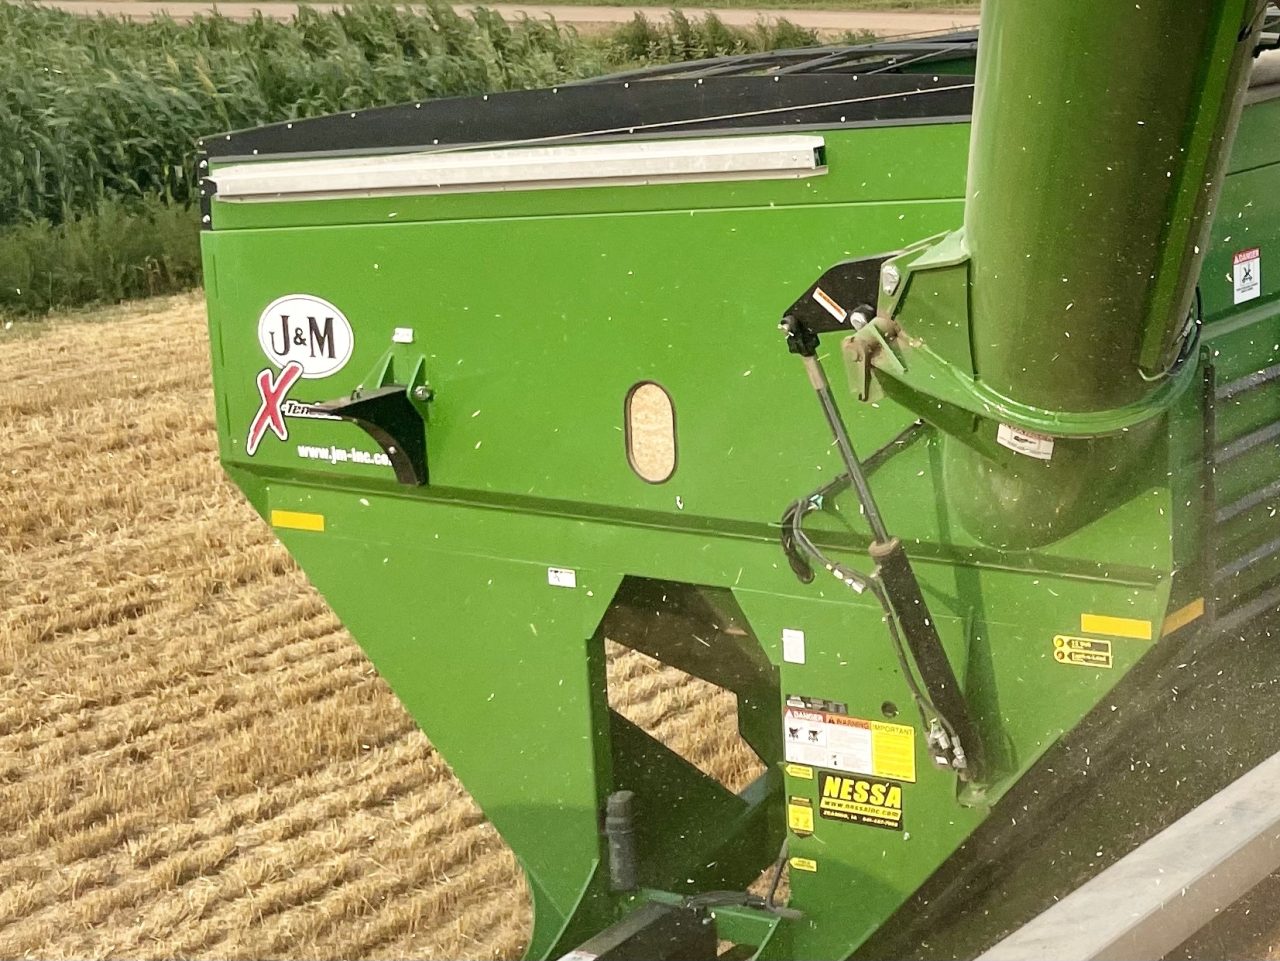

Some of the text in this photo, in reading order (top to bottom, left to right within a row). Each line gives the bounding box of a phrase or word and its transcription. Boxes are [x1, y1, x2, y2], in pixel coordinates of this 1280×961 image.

[269, 315, 336, 359] J&M
[297, 445, 393, 467] www.jm-inc.co
[873, 724, 913, 736] IMPORTANT
